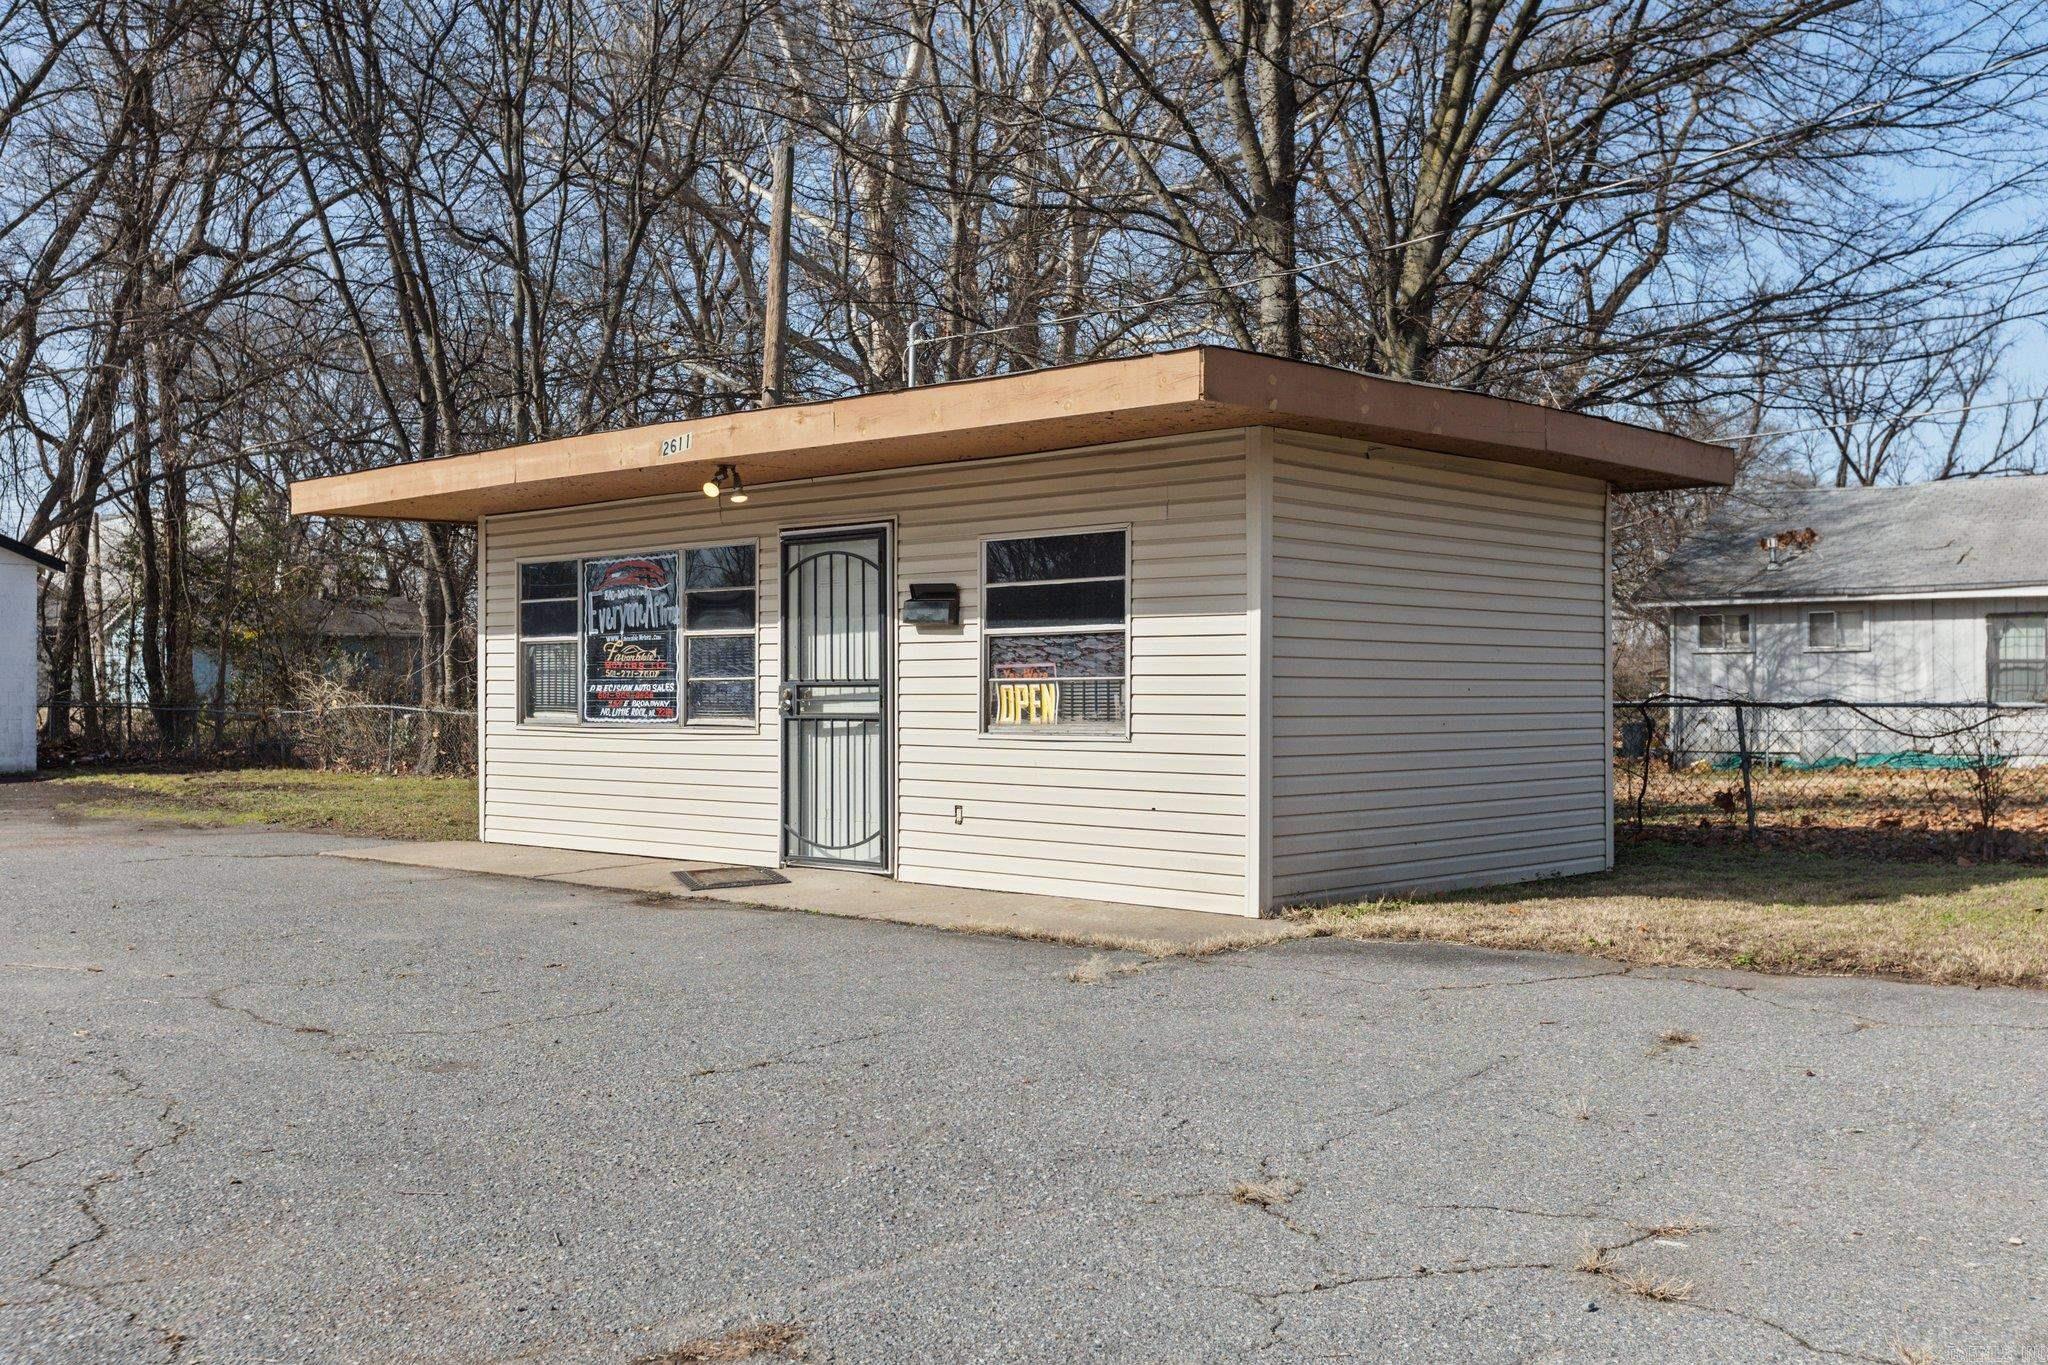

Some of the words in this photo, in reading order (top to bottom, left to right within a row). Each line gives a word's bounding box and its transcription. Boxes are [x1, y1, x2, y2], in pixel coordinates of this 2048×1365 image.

[662, 433, 690, 457] 2611
[589, 684, 633, 692] PRECISION
[634, 684, 652, 692] AUTO
[652, 683, 675, 692] SALES
[631, 699, 671, 708] BROADWAY
[1000, 683, 1055, 725] OPEN
